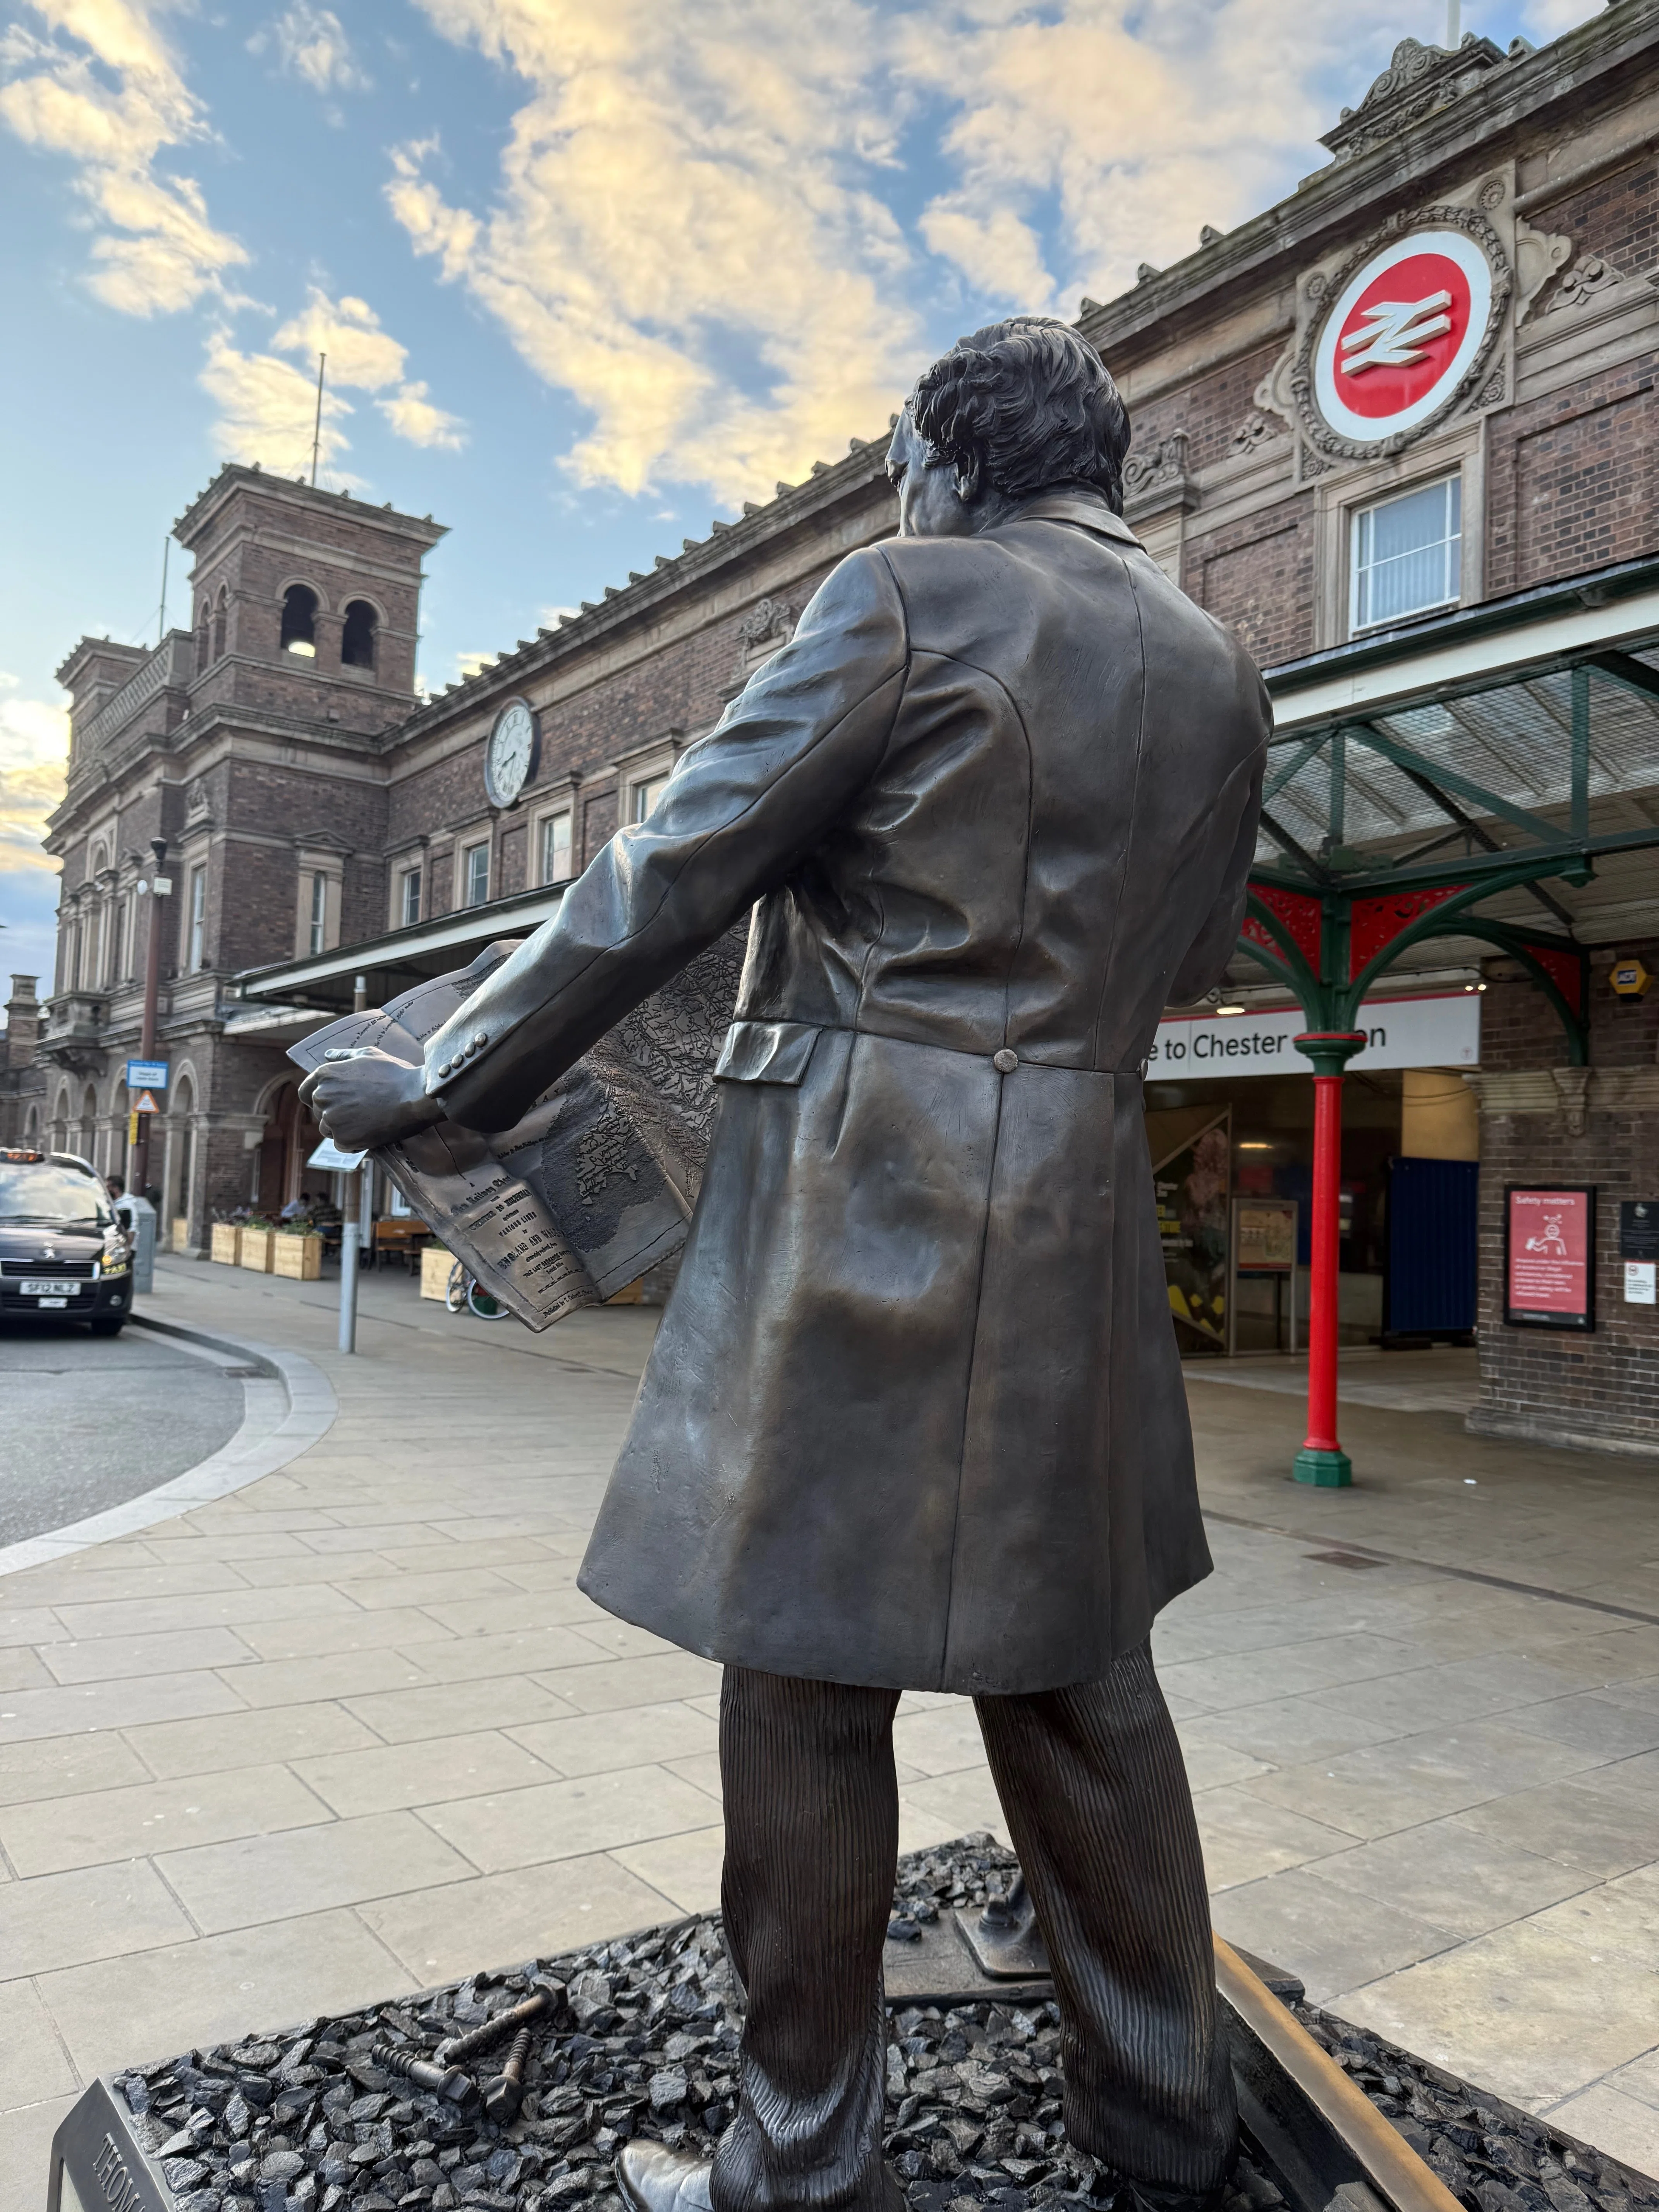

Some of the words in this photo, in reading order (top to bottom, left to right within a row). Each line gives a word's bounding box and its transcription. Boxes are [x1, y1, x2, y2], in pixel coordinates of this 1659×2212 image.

[1165, 1039, 1186, 1060] to
[1194, 1032, 1288, 1058] Chester
[529, 1234, 543, 1247] AND
[93, 2132, 146, 2212] THOM
